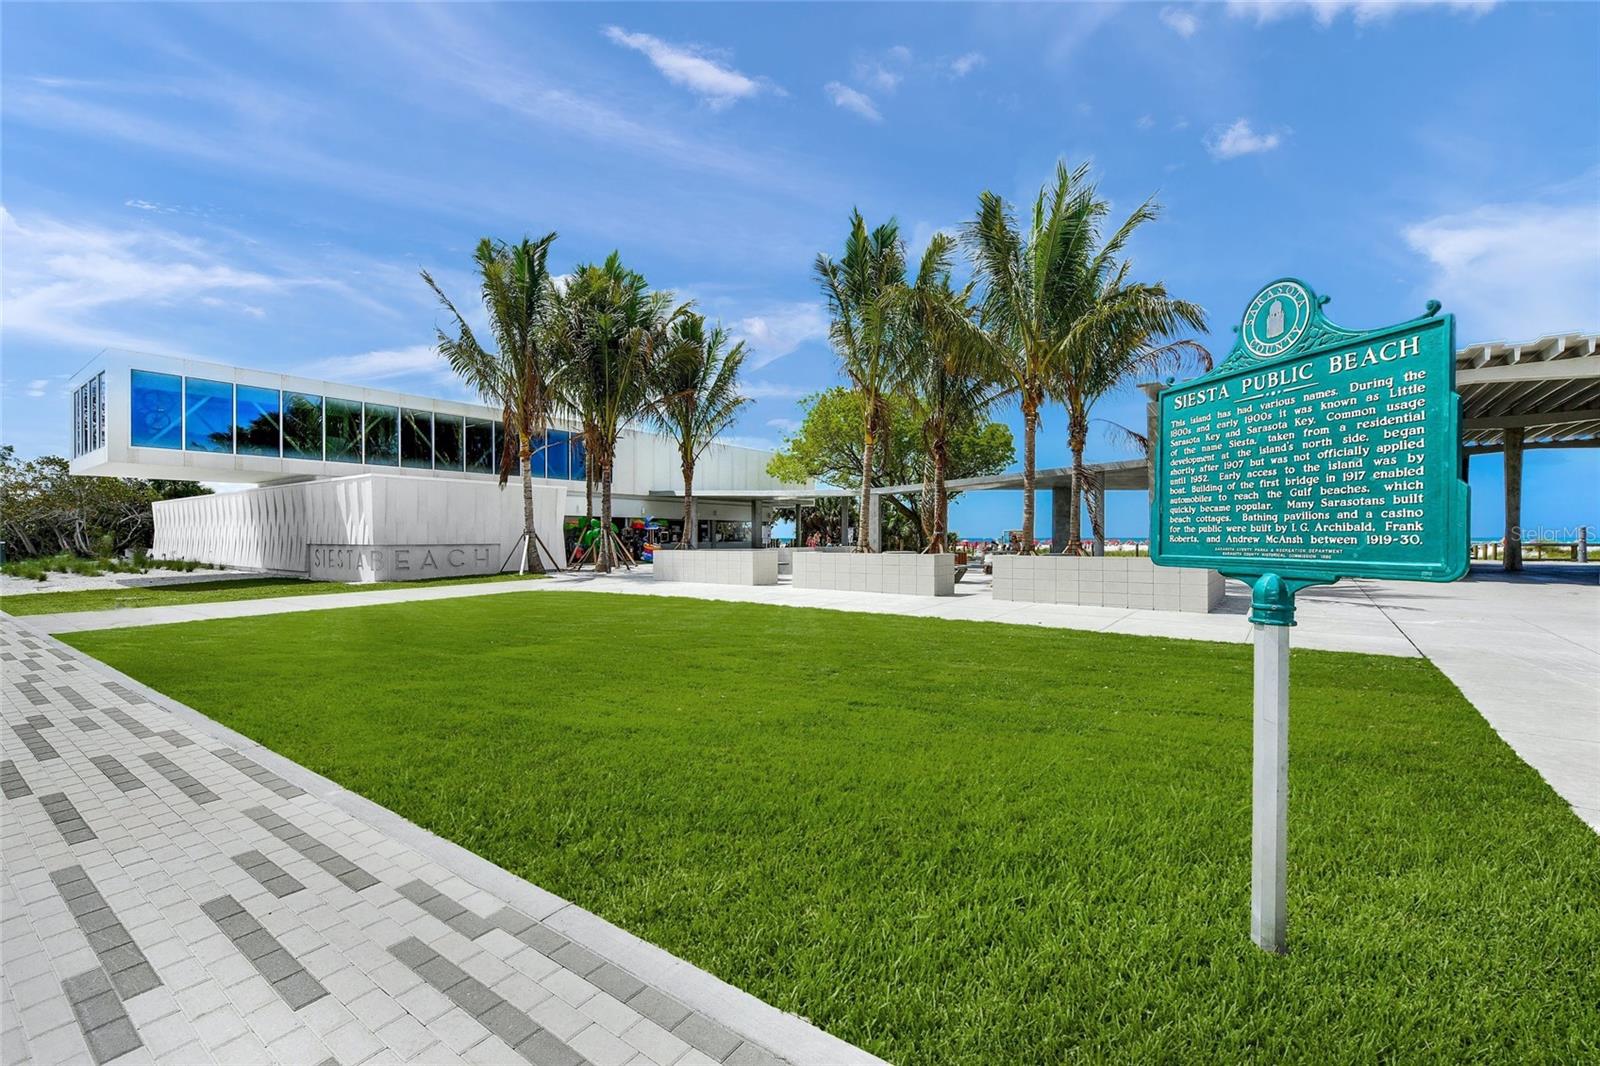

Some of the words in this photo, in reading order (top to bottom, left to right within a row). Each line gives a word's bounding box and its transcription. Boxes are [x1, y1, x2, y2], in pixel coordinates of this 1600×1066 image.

[1245, 286, 1306, 325] SARASOTA
[1249, 326, 1301, 354] COUNTY
[1174, 384, 1229, 409] SIESTA
[1242, 363, 1312, 393] PUBLIC
[1329, 336, 1419, 374] BEACH
[1191, 414, 1211, 424] island
[1217, 410, 1231, 418] has
[1237, 405, 1252, 414] had
[1261, 397, 1295, 409] various
[1350, 377, 1393, 392] During
[1404, 370, 1426, 381] the
[1197, 424, 1209, 432] and
[1217, 420, 1238, 430] early
[1245, 413, 1272, 423] 1900s
[1295, 405, 1312, 414] was
[1321, 398, 1357, 410] known
[1390, 385, 1425, 397] Little
[1170, 437, 1200, 447] Sarasota
[1206, 433, 1220, 442] Key
[1226, 429, 1240, 437] and
[1247, 421, 1287, 434] Sarasota
[1327, 407, 1376, 421] Common
[1387, 398, 1425, 411] usage
[1202, 443, 1222, 451] name
[1268, 432, 1294, 442] taken
[1304, 427, 1329, 436] from
[1357, 411, 1425, 429] residential
[1170, 455, 1215, 466] development
[1238, 449, 1251, 457] the
[1260, 442, 1293, 454] island's
[1303, 438, 1332, 448] north
[1384, 426, 1424, 438] began
[1170, 467, 1195, 475] shortly
[1200, 464, 1219, 472] after
[1224, 460, 1244, 469] 1907
[1250, 458, 1264, 466] but
[1271, 456, 1287, 464] was
[1294, 452, 1310, 461] not
[1318, 445, 1369, 459] officially
[1377, 438, 1424, 453] applied
[1170, 477, 1186, 485] until
[1220, 472, 1240, 480] Early
[1247, 468, 1277, 477] access
[1304, 464, 1320, 472] the
[1328, 459, 1362, 470] island
[1374, 457, 1397, 465] was
[1408, 453, 1424, 463] by
[1192, 485, 1222, 493] Building
[1227, 482, 1235, 490] of
[1241, 481, 1254, 489] the
[1260, 479, 1279, 487] first
[1286, 477, 1319, 486] bridge
[1326, 474, 1335, 482] in
[1343, 471, 1366, 481] 1917
[1373, 466, 1424, 478] enabled
[1170, 495, 1212, 504] automobiles
[1234, 492, 1259, 500] reach
[1267, 490, 1282, 498] the
[1290, 488, 1312, 496] Gulf
[1384, 480, 1424, 491] which
[1170, 506, 1196, 514] quickly
[1200, 503, 1231, 512] became
[1287, 500, 1314, 509] Many
[1321, 497, 1385, 507] Sarasotans
[1393, 494, 1424, 504] built
[1170, 515, 1191, 523] beach
[1243, 513, 1278, 523] Bathing
[1284, 511, 1329, 521] pavilions
[1337, 510, 1358, 519] and
[1381, 509, 1423, 518] casino
[1199, 525, 1222, 533] public
[1251, 524, 1271, 532] built
[1276, 524, 1287, 533] by
[1385, 521, 1423, 531] Frank
[1207, 535, 1220, 543] and
[1226, 535, 1260, 543] Andrew
[1266, 535, 1303, 543] McAnsh
[1311, 535, 1357, 544] between
[314, 549, 364, 571] SIESTA
[370, 548, 489, 571] BEACH
